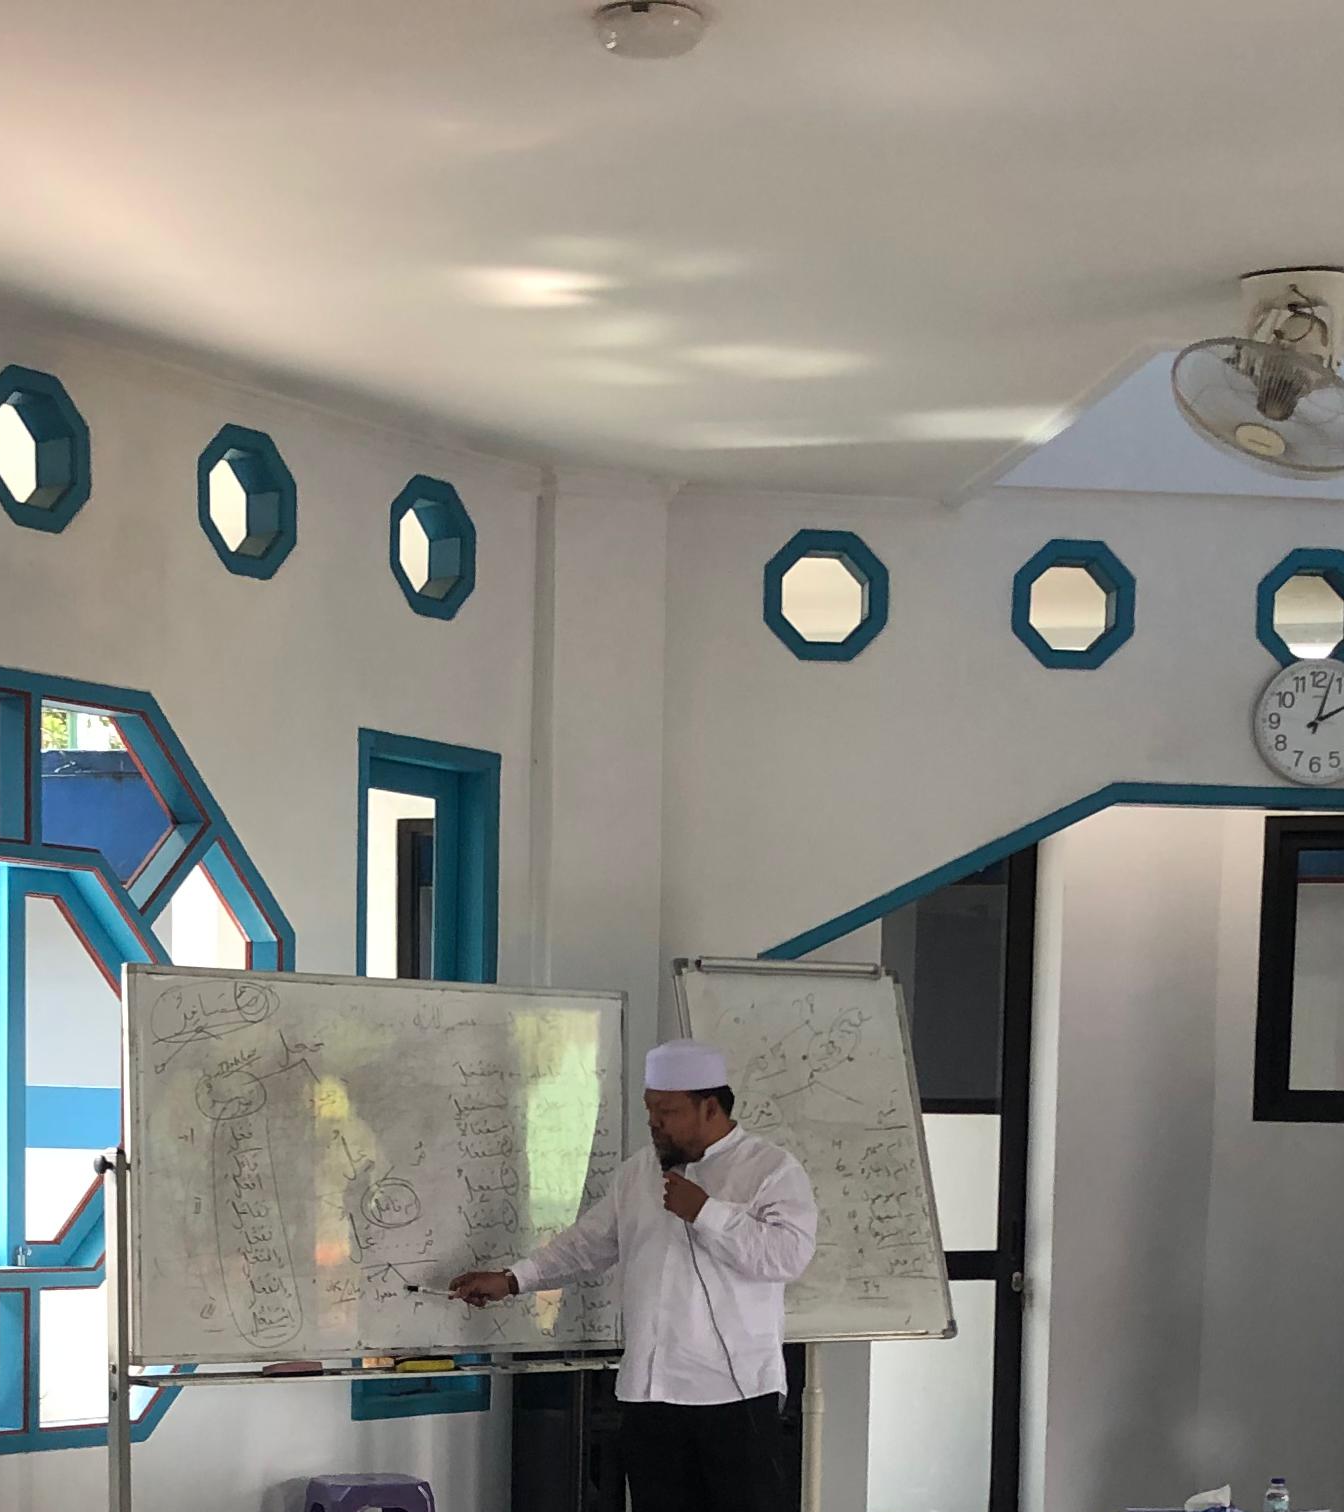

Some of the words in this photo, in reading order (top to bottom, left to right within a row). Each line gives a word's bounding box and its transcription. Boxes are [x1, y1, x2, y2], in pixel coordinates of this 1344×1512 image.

[1293, 676, 1305, 693] 11
[1310, 671, 1327, 688] 12
[1336, 677, 1343, 694] 1
[1276, 691, 1295, 709] 10
[1268, 712, 1281, 729] 9
[1275, 734, 1287, 751] 8
[1293, 750, 1304, 767] 7
[1309, 756, 1321, 773] 6
[1328, 751, 1341, 768] 5
